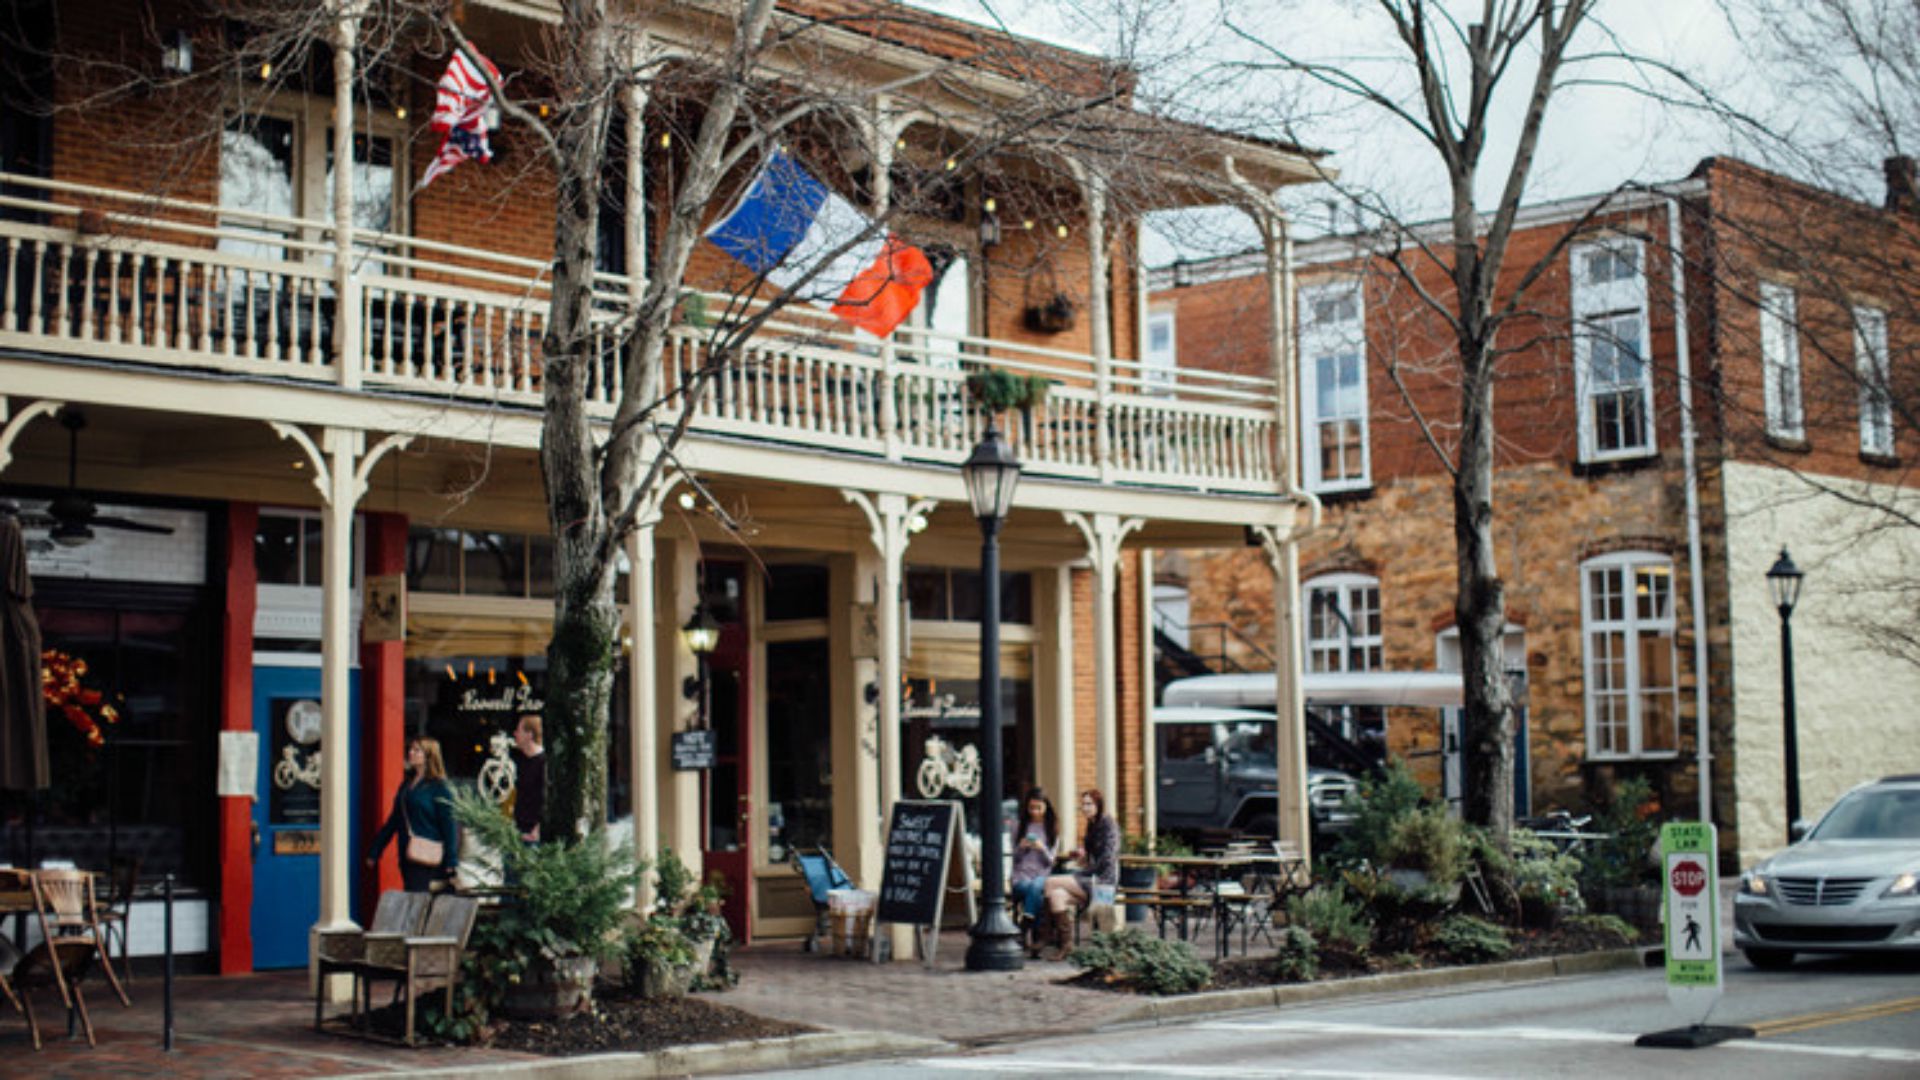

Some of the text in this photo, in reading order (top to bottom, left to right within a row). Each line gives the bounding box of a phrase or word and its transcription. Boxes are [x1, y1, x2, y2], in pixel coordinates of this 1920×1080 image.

[1670, 827, 1703, 838] STATE
[1675, 839, 1698, 849] LAW
[1672, 870, 1705, 887] STOP
